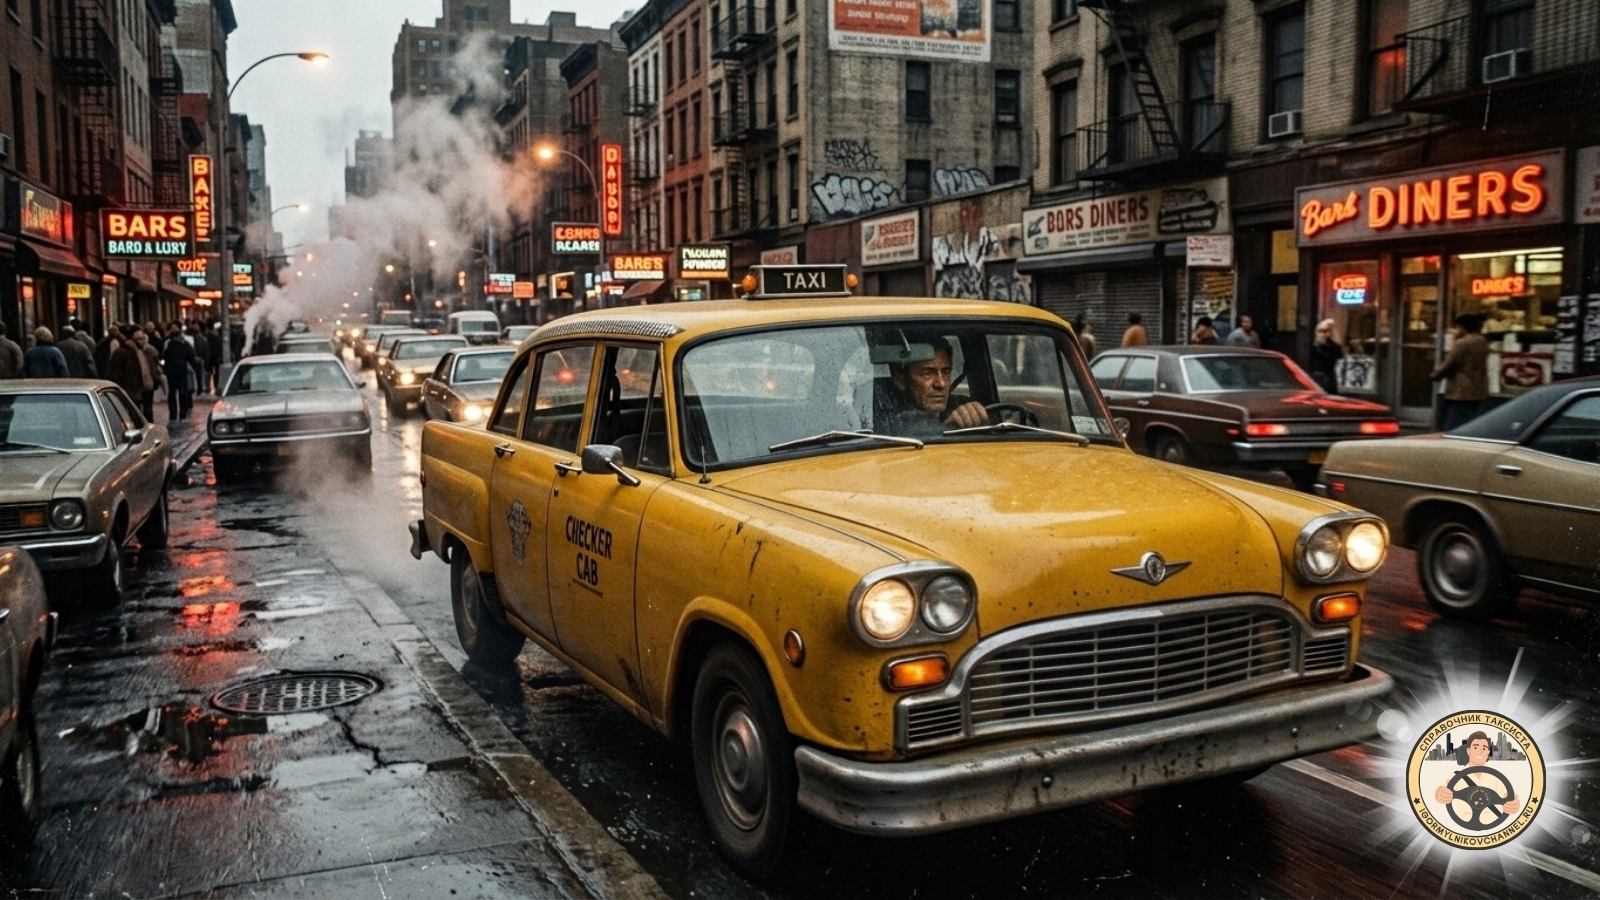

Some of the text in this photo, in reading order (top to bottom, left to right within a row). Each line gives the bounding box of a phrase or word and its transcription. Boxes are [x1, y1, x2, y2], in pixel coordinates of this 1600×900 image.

[1368, 164, 1543, 229] DINERS
[109, 214, 187, 238] BARS
[1047, 207, 1083, 234] BORS
[1090, 196, 1149, 228] DINERS
[783, 271, 826, 289] TAXI
[565, 515, 612, 560] CHECKER
[576, 552, 598, 587] CAB
